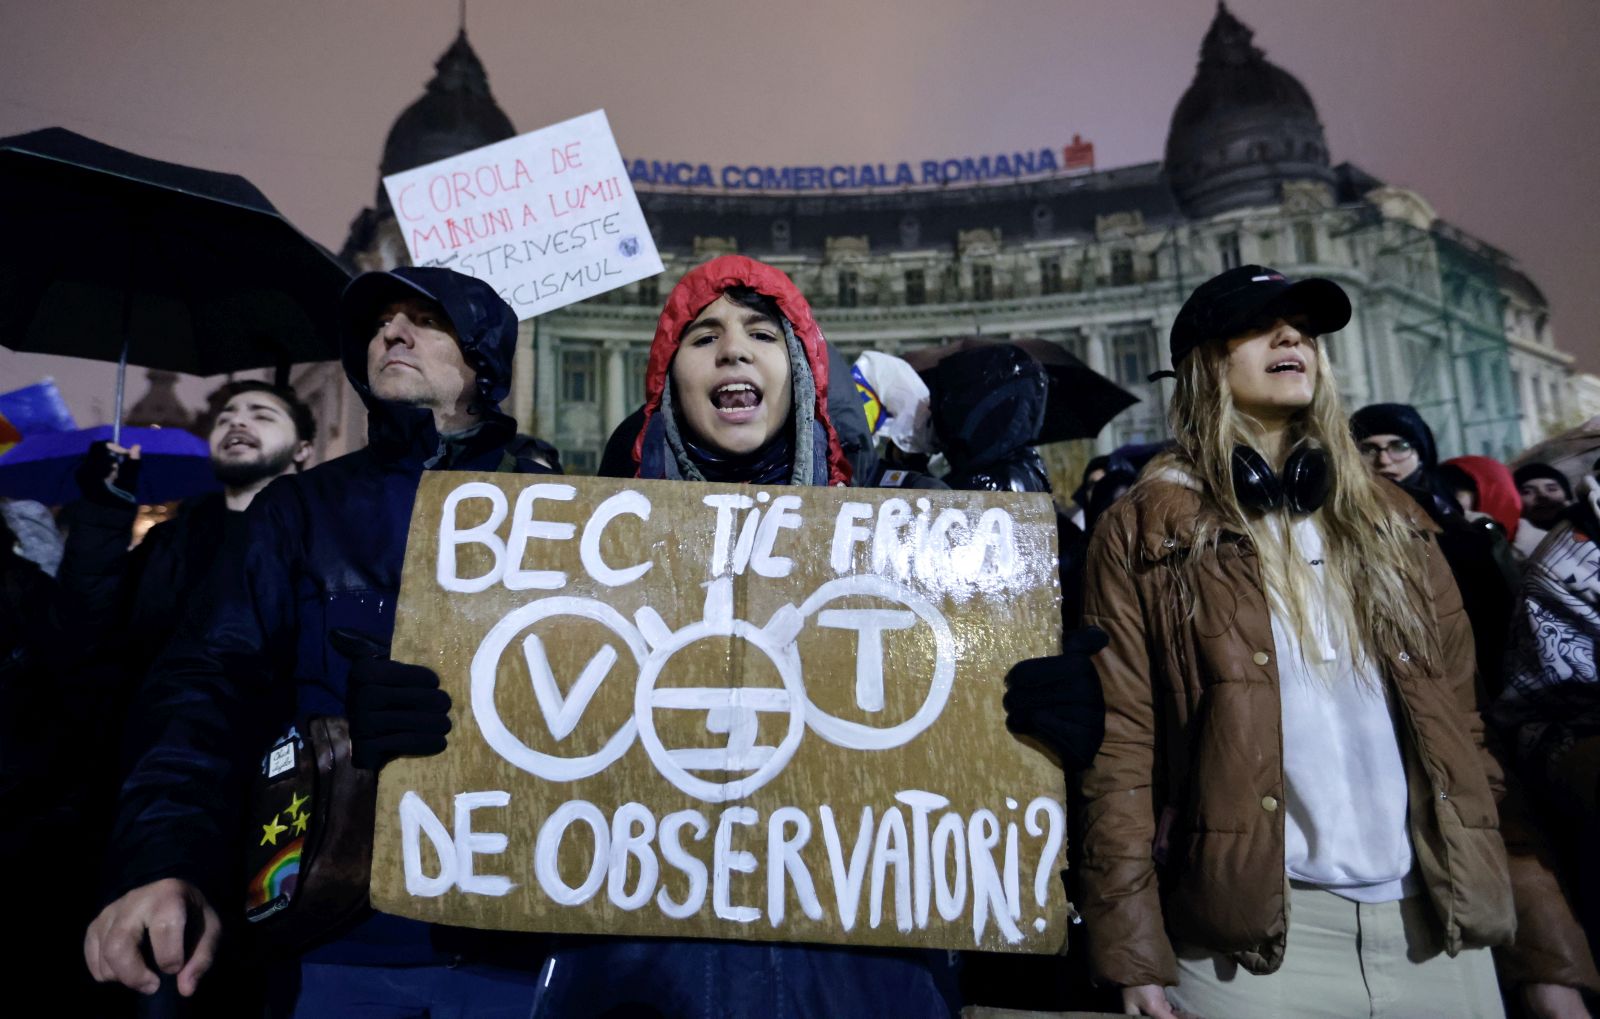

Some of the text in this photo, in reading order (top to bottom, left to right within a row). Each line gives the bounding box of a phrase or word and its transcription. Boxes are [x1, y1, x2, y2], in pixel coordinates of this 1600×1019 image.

[399, 142, 582, 222] COROLA DE
[624, 147, 1059, 190] ANCA COMERCIALA ROMANA
[413, 207, 515, 259] MINUNI
[522, 204, 538, 227] A
[548, 177, 623, 218] LUMII
[460, 212, 620, 277] STRIVESTE
[498, 258, 622, 307] SCISMUL
[436, 482, 653, 593] BEC
[399, 790, 516, 898] DE
